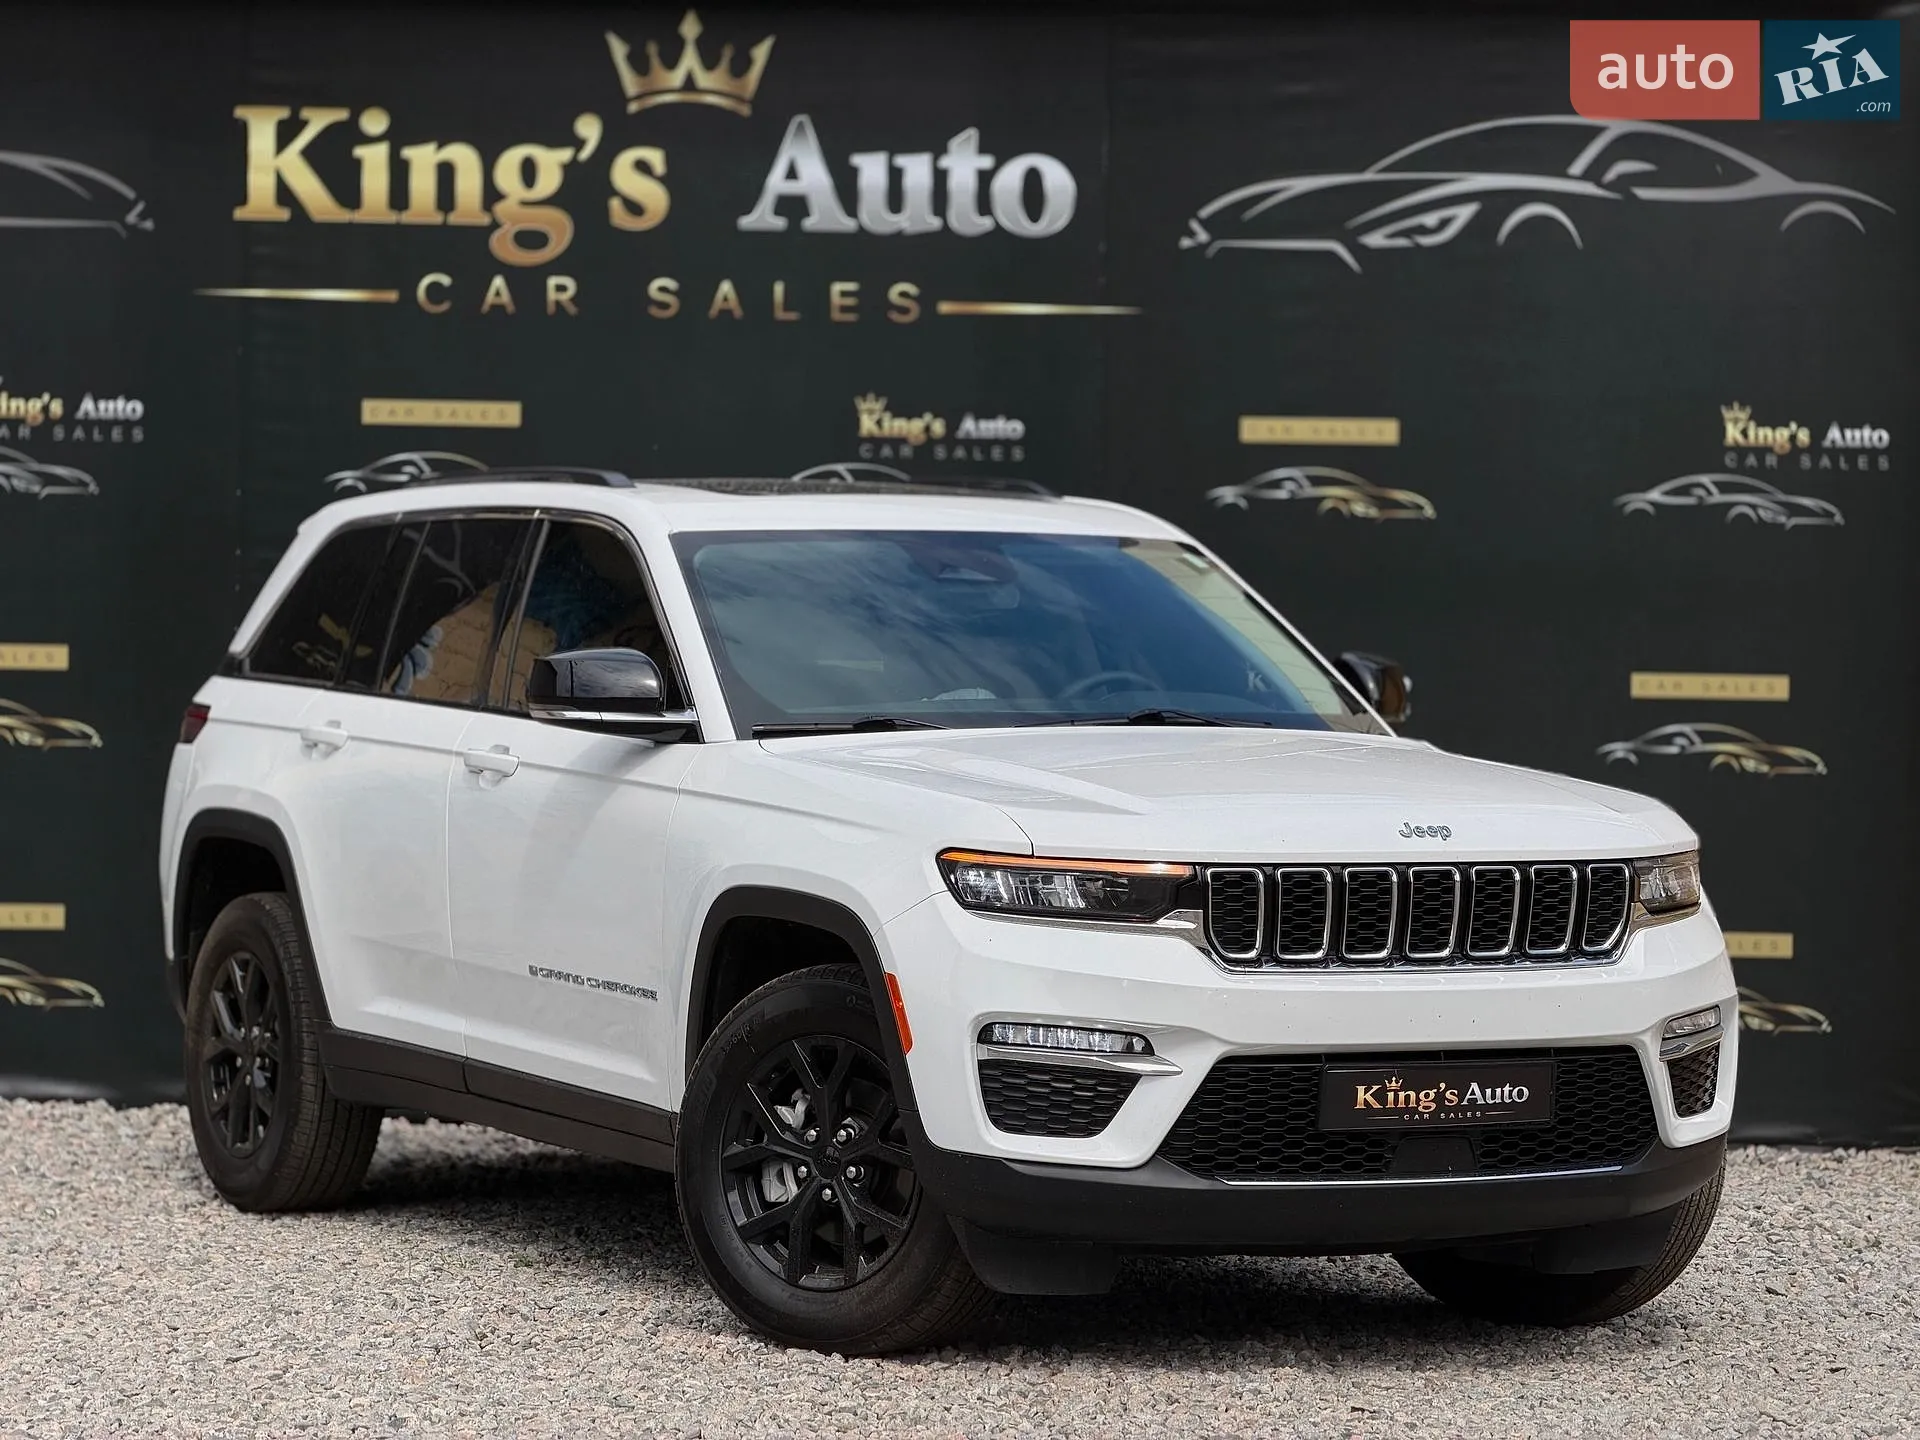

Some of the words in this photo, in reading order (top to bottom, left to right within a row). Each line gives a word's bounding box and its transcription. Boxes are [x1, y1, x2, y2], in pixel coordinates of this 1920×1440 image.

[232, 105, 671, 267] King's
[737, 113, 1078, 239] Auto
[416, 272, 579, 315] CAR
[647, 277, 921, 323] SALES
[0, 390, 64, 426] ing's
[74, 391, 145, 421] Auto
[0, 424, 31, 441] AR
[52, 424, 145, 442] SALES
[857, 410, 947, 446] King's
[955, 411, 1026, 440] Auto
[1723, 418, 1811, 455] King's
[1821, 420, 1890, 449] Auto
[858, 442, 914, 459] CAR
[933, 444, 1025, 462] SALES
[1724, 451, 1778, 469] CAR
[1800, 453, 1890, 471] SALES
[1398, 822, 1452, 841] Jeep
[538, 967, 585, 985] GRAND
[586, 976, 658, 1002] CHEROKEE
[1354, 1082, 1459, 1112] King's
[1460, 1082, 1530, 1106] Auto
[1440, 1111, 1482, 1120] SALES
